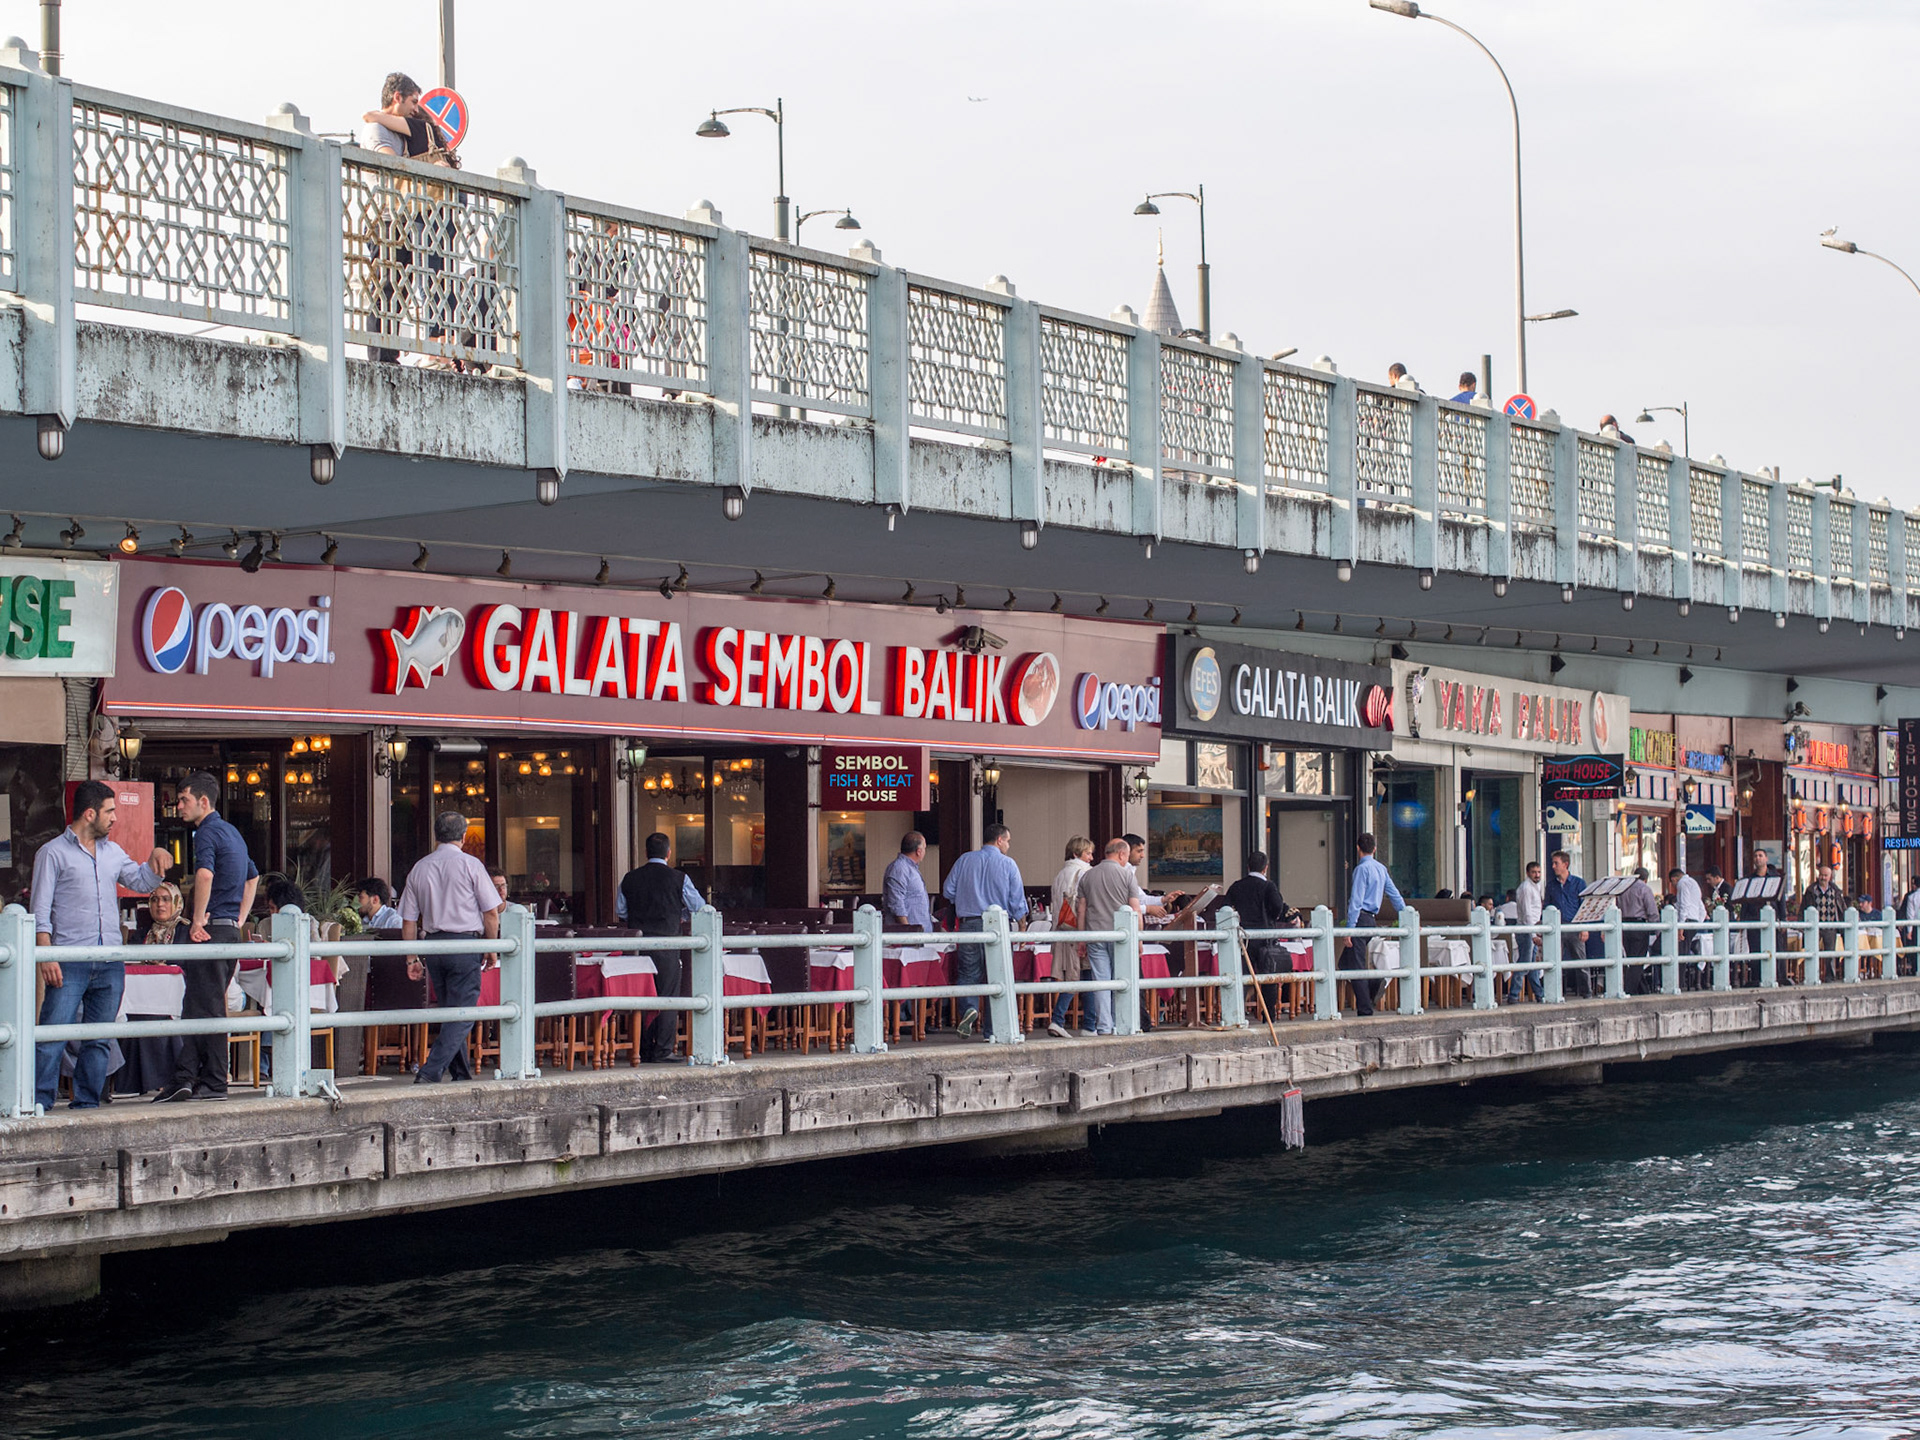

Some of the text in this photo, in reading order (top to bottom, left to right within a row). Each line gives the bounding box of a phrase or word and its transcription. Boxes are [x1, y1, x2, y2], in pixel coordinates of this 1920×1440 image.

[196, 595, 331, 678] pepsi
[477, 604, 1007, 723] GALATA SEMBOL BALIK
[1195, 667, 1217, 695] EFES
[1100, 676, 1161, 732] pepsi
[1235, 663, 1361, 728] GALATA BALIK
[1436, 679, 1582, 745] YAKA BALIK
[829, 774, 914, 787] FISH & MEAT
[835, 755, 909, 770] SEMBOL
[1545, 763, 1611, 780] FISH HOUSE
[1905, 721, 1917, 833] FISH HOUSE
[846, 790, 897, 802] HOUSE
[1554, 789, 1613, 800] CAFE & BAR
